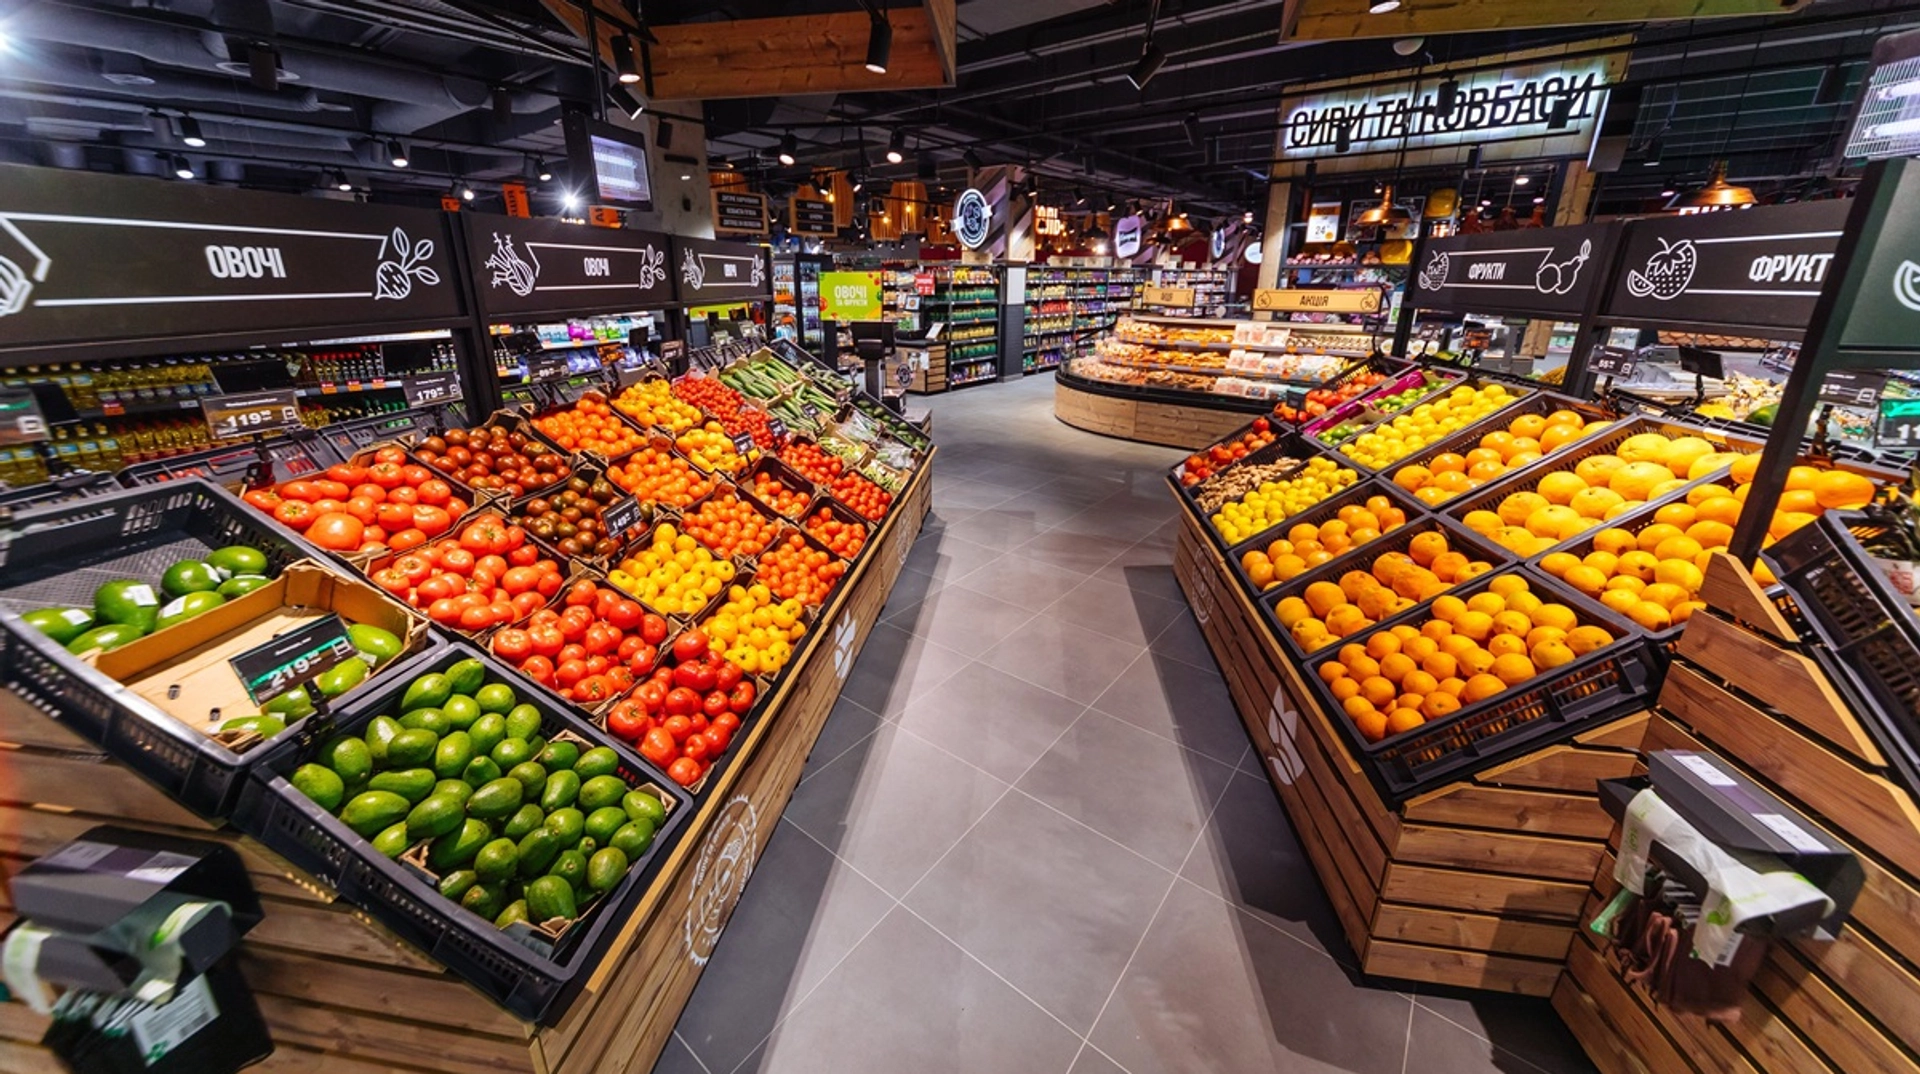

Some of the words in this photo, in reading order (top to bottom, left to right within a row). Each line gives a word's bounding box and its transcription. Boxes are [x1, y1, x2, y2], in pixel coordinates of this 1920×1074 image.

[1291, 103, 1367, 145] СИРИ
[1376, 98, 1410, 139] ТА
[205, 245, 287, 278] ОВОЧІ
[583, 257, 610, 276] ОВОЧІ
[1468, 262, 1506, 280] ФРУКТИ
[834, 285, 867, 299] ОВОЧІ
[1300, 295, 1329, 306] АКЦІЯ
[416, 388, 438, 401] 179
[227, 412, 261, 427] 119
[269, 657, 310, 688] 219
